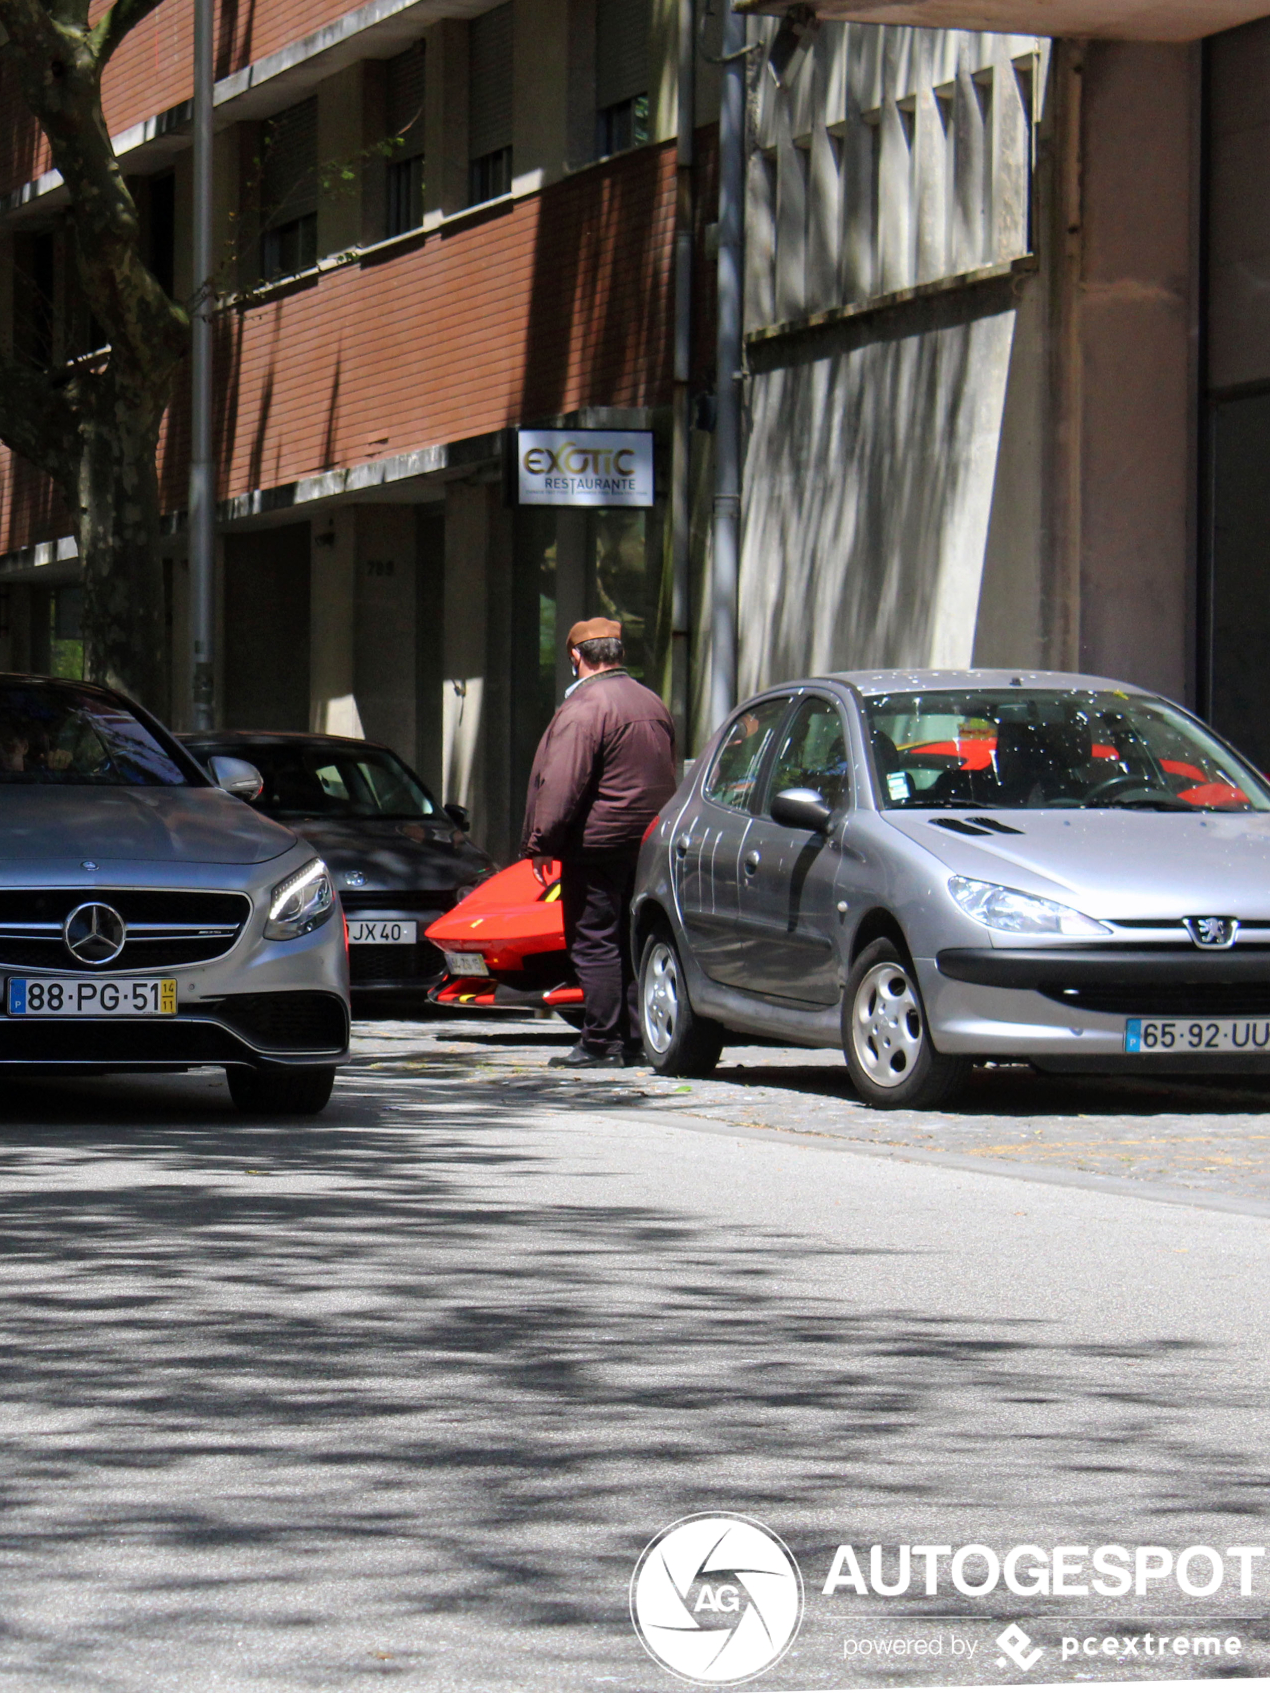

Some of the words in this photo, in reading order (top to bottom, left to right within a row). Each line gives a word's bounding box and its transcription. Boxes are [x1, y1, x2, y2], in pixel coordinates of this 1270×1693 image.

[545, 478, 636, 495] RESTAURANTE
[380, 924, 401, 941] 40
[163, 983, 174, 993] 14
[15, 1001, 22, 1009] P
[163, 1001, 173, 1010] 11
